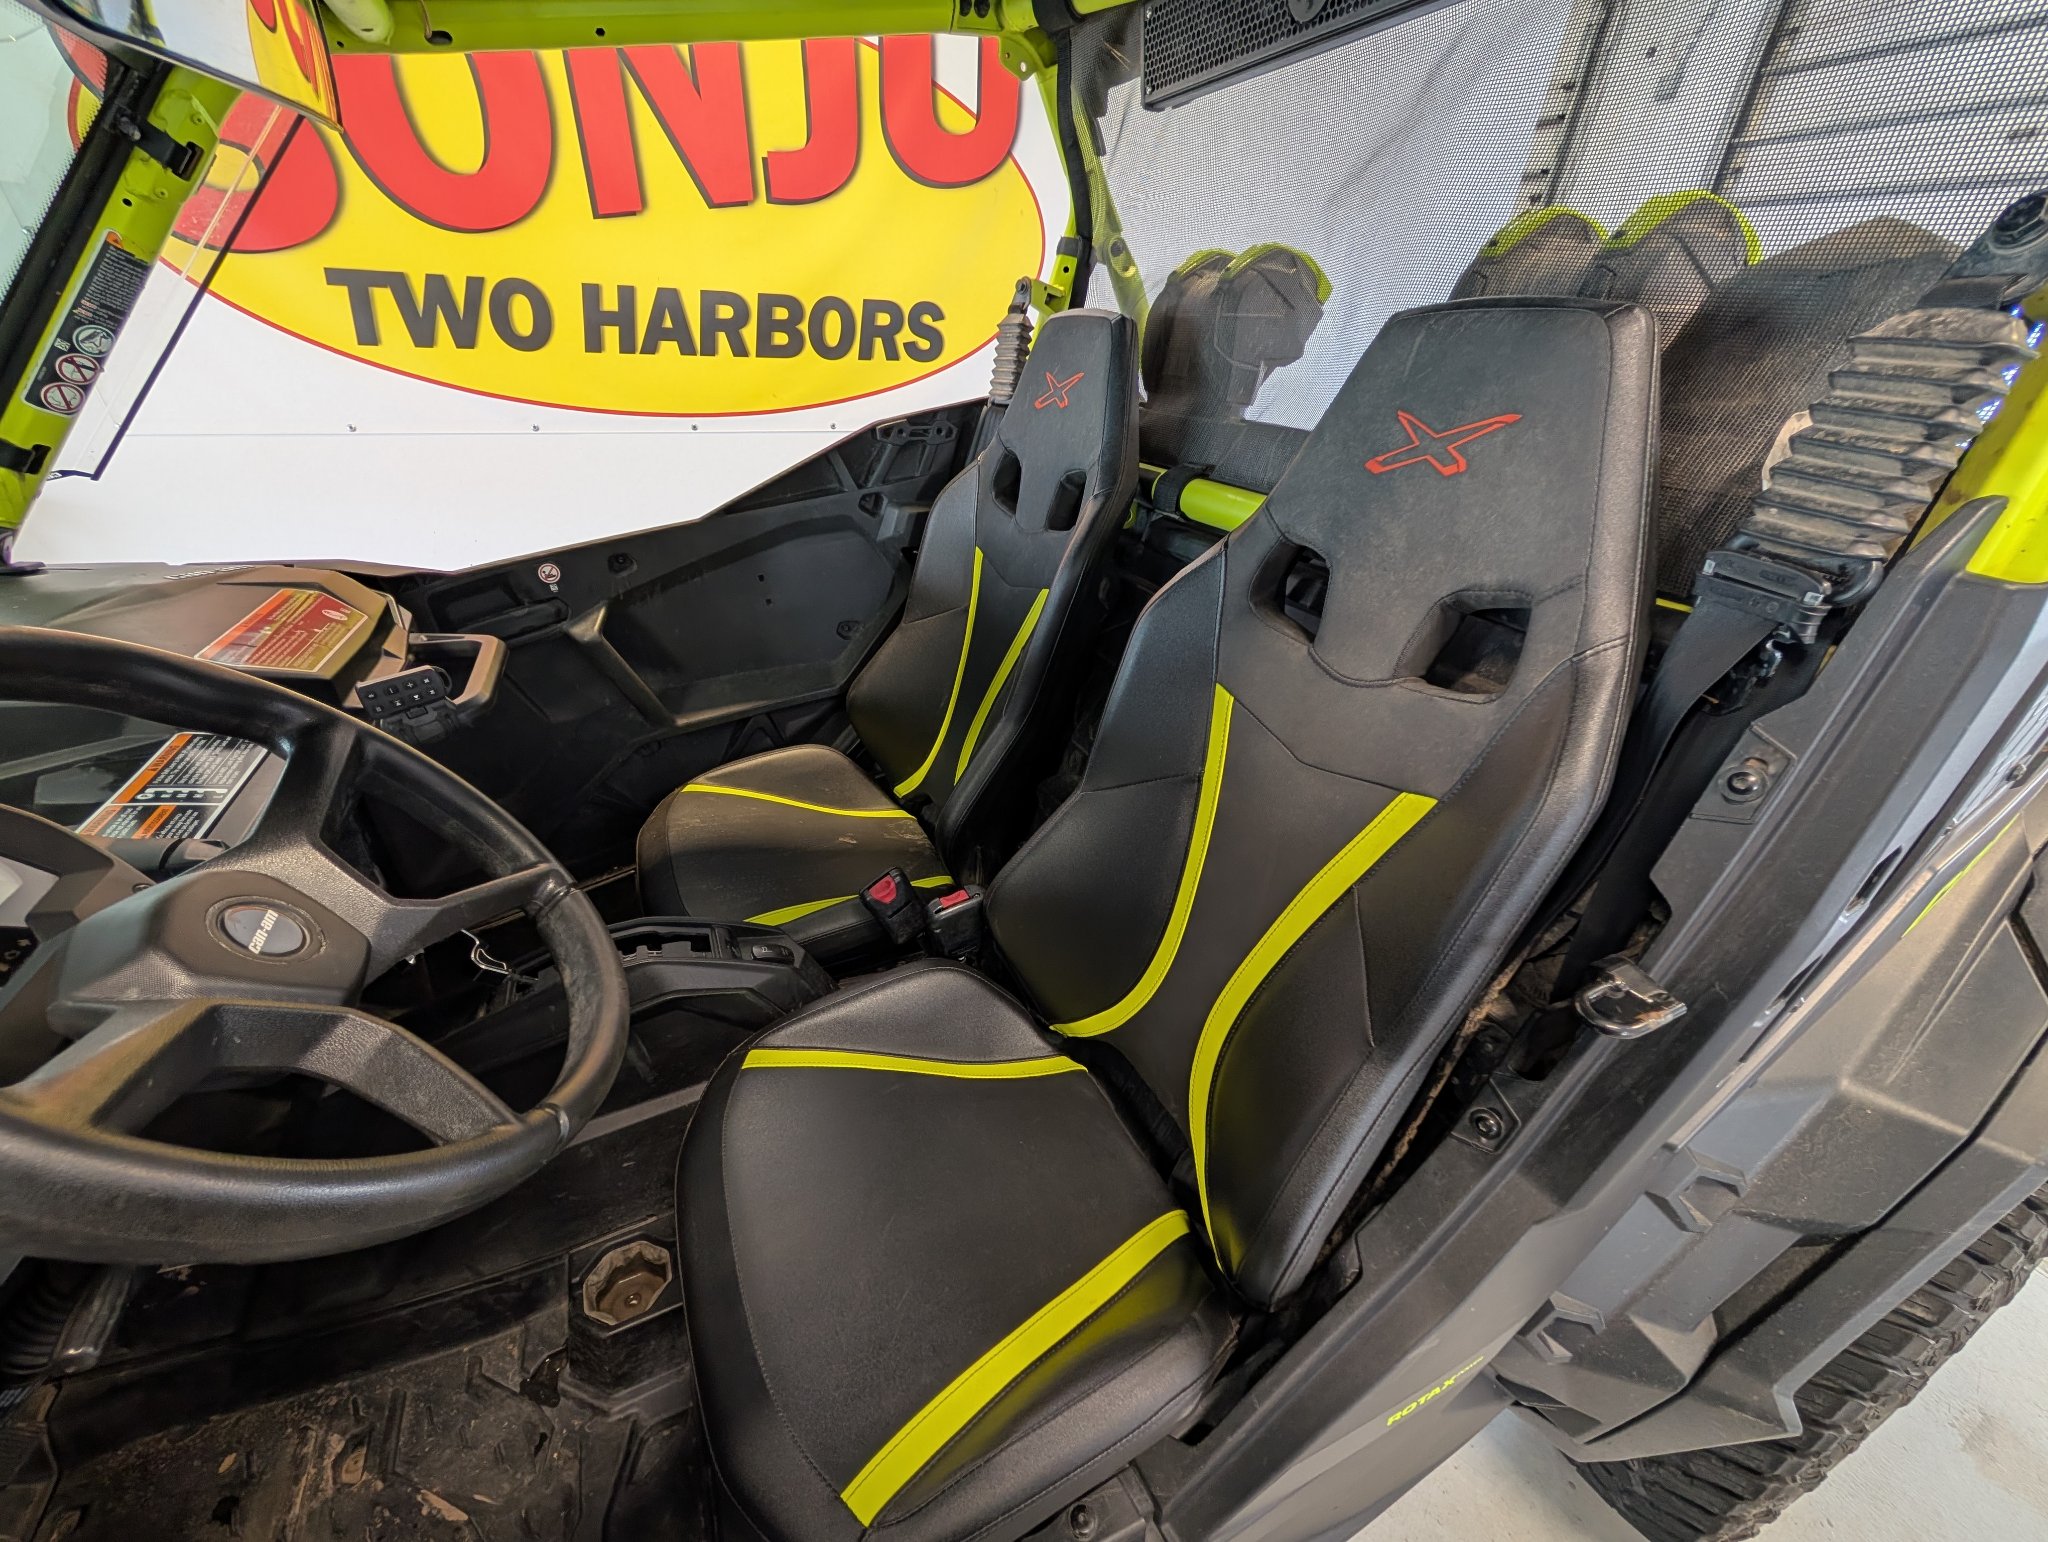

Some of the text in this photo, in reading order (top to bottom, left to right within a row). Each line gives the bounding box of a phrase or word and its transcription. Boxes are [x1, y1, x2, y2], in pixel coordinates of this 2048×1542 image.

[323, 266, 945, 363] TWO HARBORS
[248, 909, 279, 954] can-am
[1386, 1376, 1456, 1426] ROTAX
